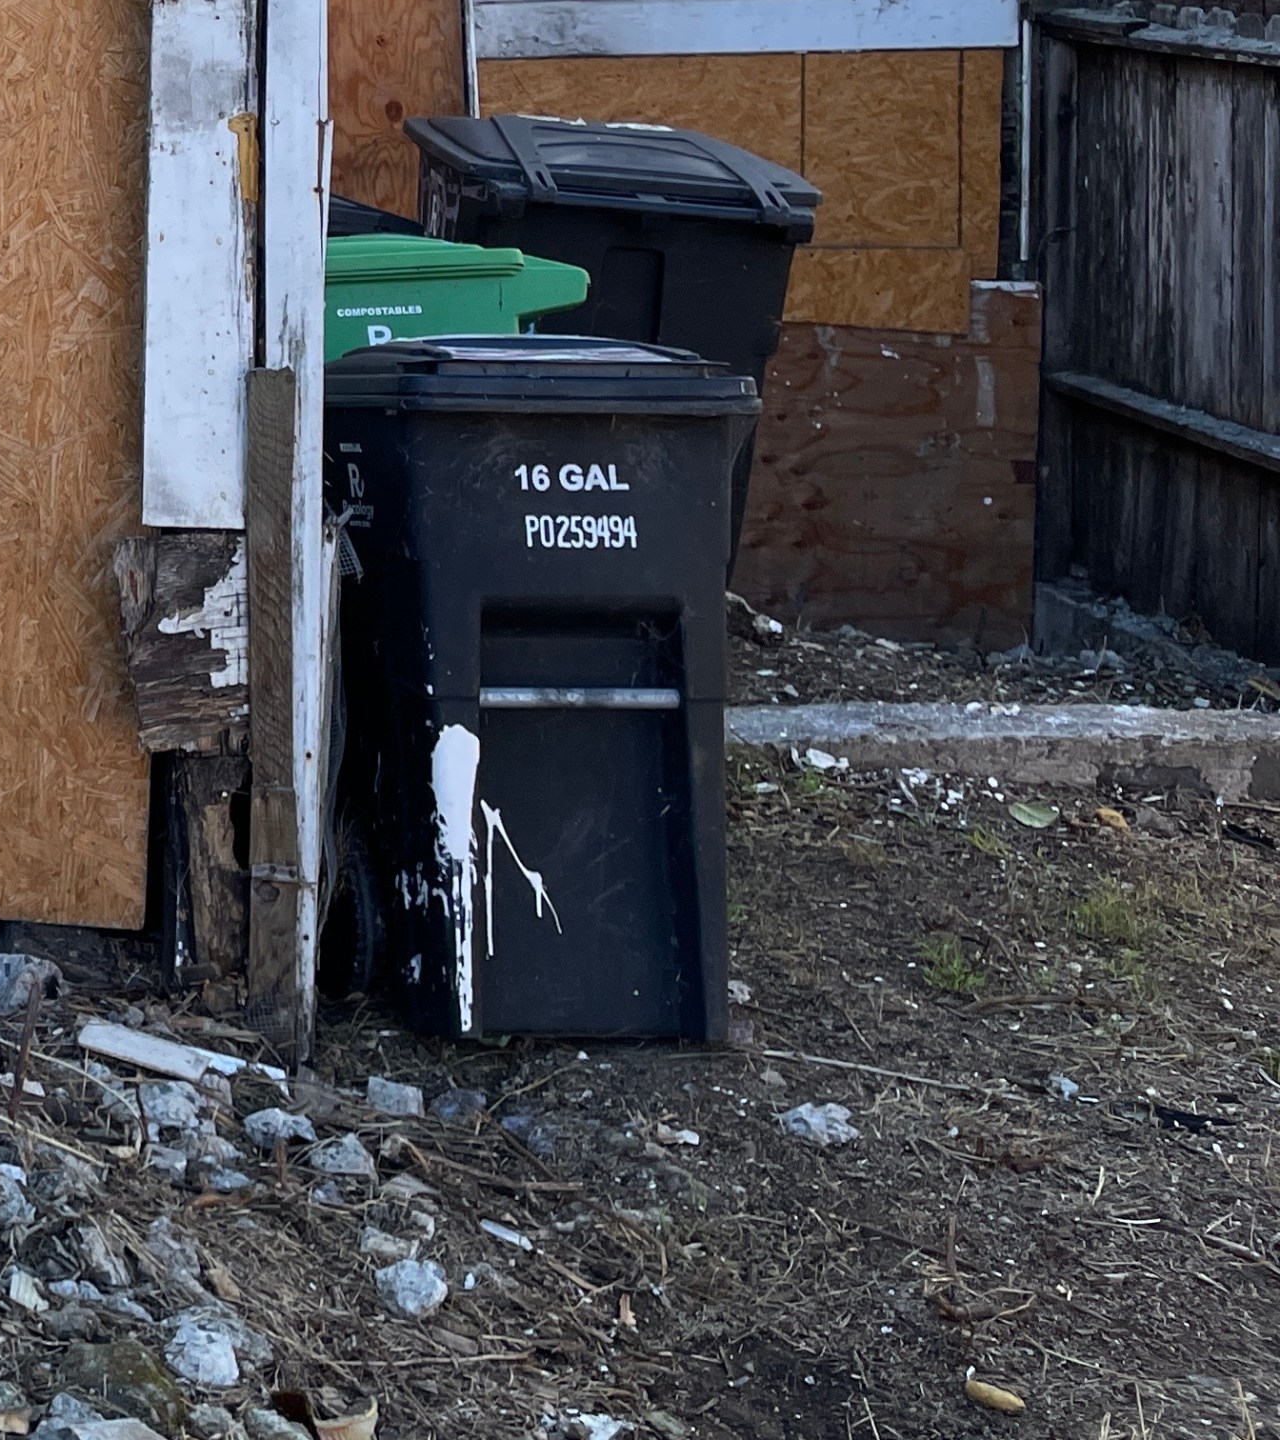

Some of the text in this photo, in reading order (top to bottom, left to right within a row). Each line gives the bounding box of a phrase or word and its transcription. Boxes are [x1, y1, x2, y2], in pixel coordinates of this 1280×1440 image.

[336, 305, 423, 318] COMPOSTABLES
[514, 463, 630, 492] 16 GAL
[524, 514, 638, 549] P0259494
